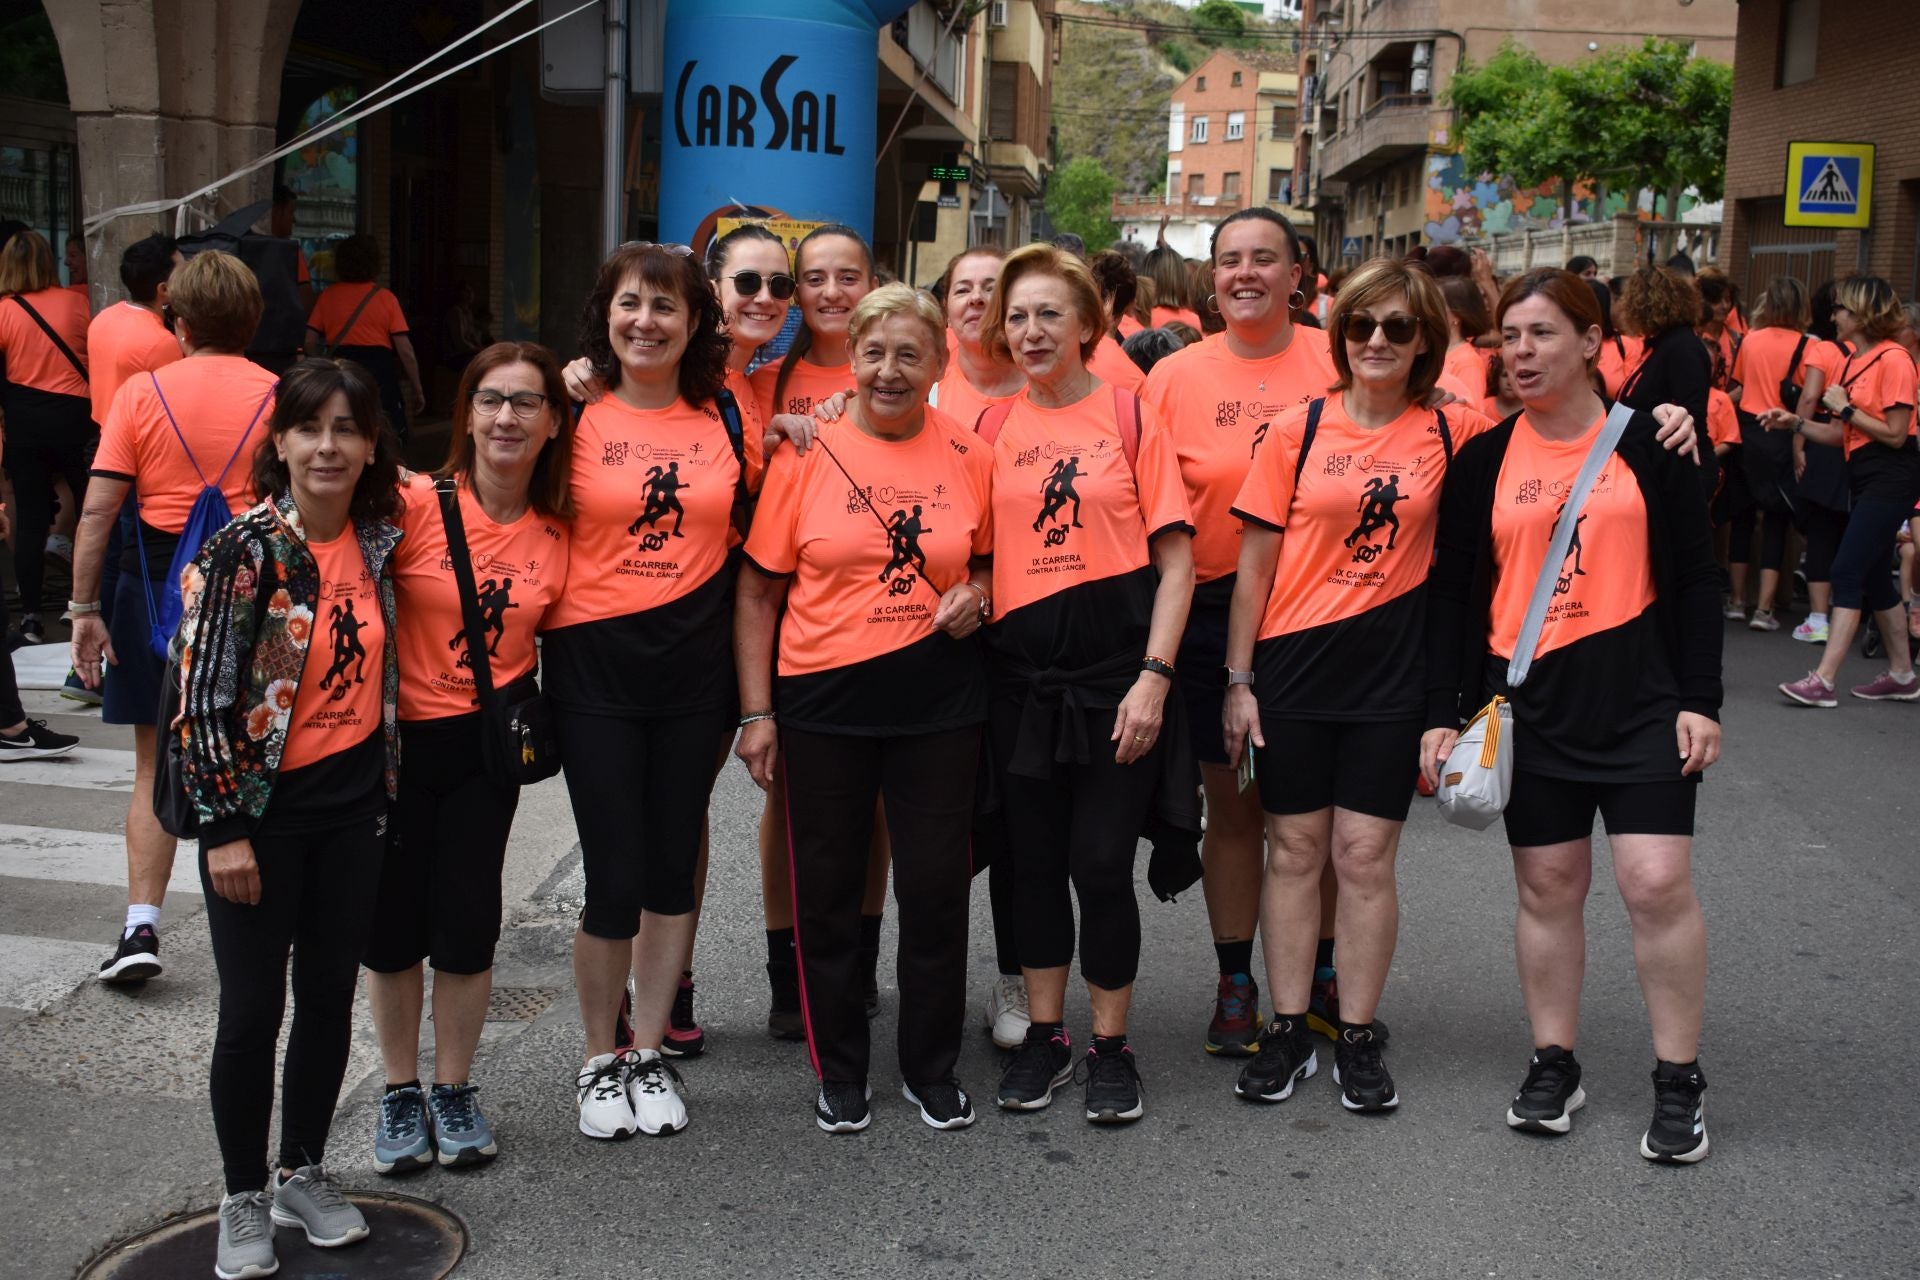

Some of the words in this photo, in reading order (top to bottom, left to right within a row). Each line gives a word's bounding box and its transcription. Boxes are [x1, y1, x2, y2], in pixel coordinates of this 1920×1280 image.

[623, 559, 632, 567] IX
[634, 560, 679, 570] CARRERA
[1032, 558, 1041, 566] IX
[1042, 554, 1082, 565] CARRERA
[615, 567, 645, 577] CONTRA
[1026, 567, 1054, 575] CONTRA
[1335, 568, 1344, 577] IX
[1346, 571, 1386, 580] CARRERA
[874, 607, 883, 615] IX
[885, 603, 928, 614] CARRERA
[866, 616, 896, 624] CONTRA
[440, 672, 450, 681] IX
